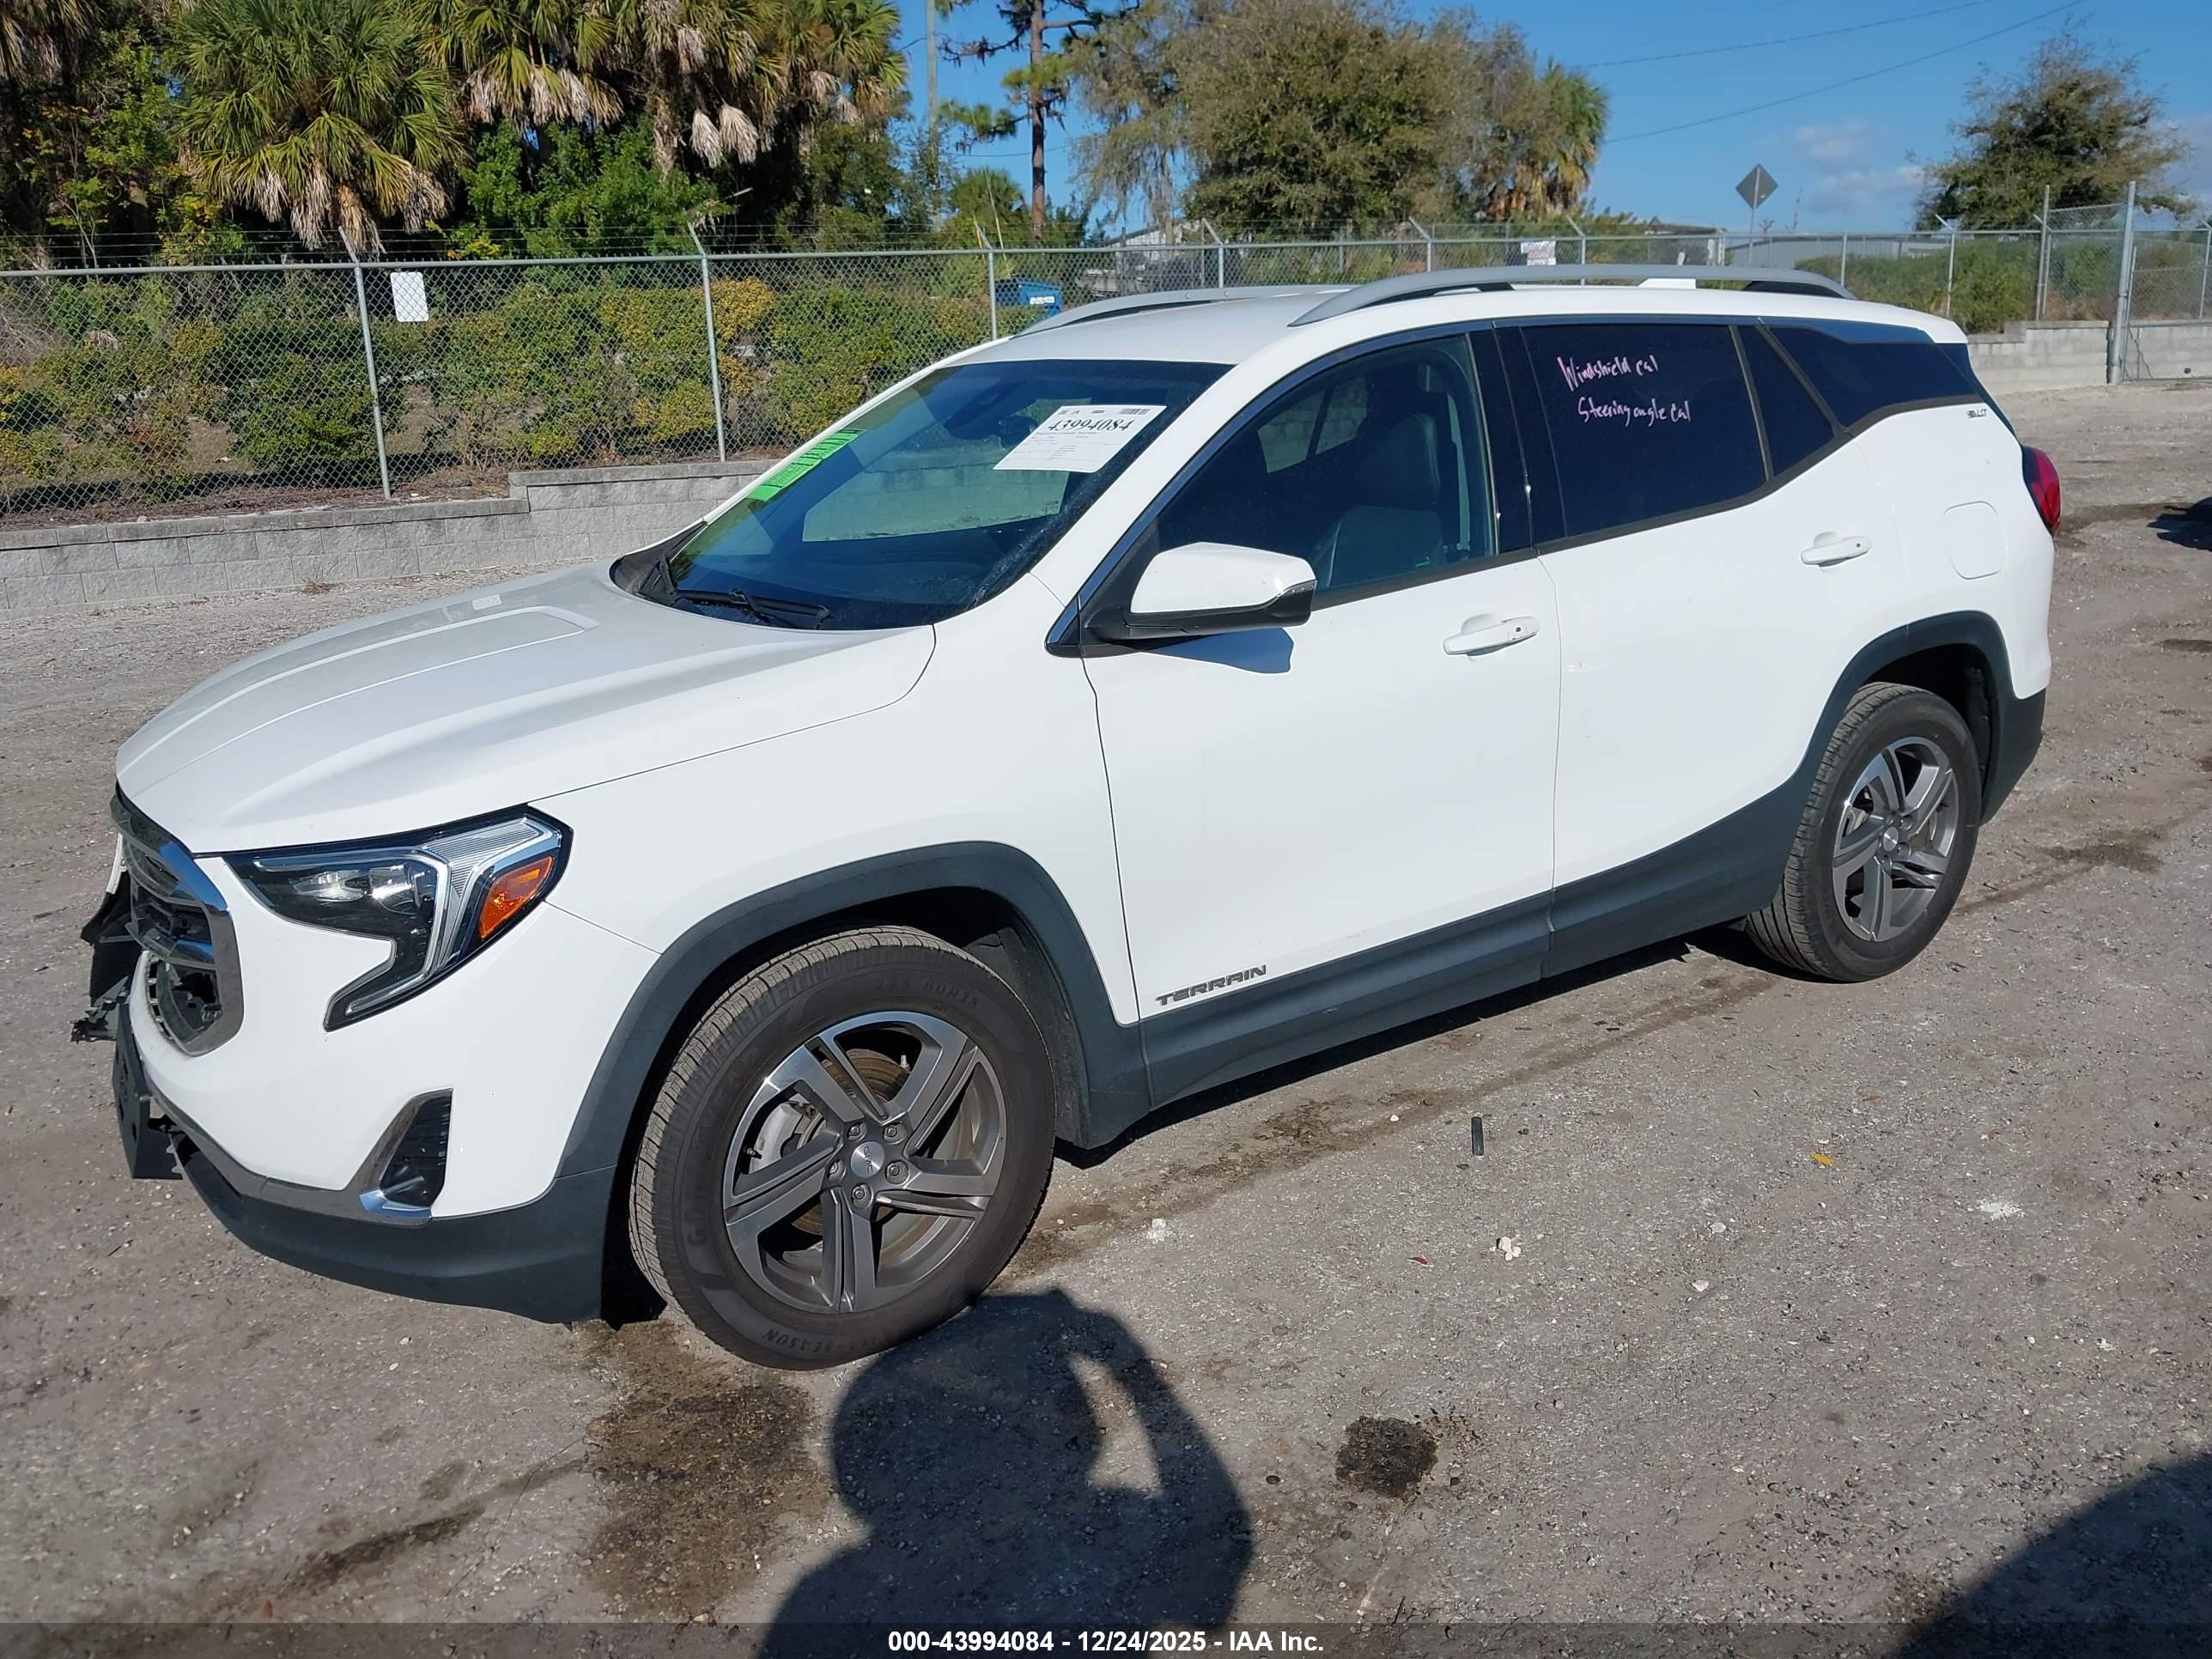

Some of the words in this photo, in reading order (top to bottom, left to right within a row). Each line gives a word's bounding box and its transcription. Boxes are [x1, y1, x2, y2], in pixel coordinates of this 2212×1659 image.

[1557, 356, 1632, 392] Windshield
[1048, 418, 1135, 431] 43994084
[1577, 396, 1631, 428] Steering
[1633, 398, 1668, 427] angle
[1155, 963, 1267, 1006] TERRAIN
[863, 1146, 873, 1176] GMC
